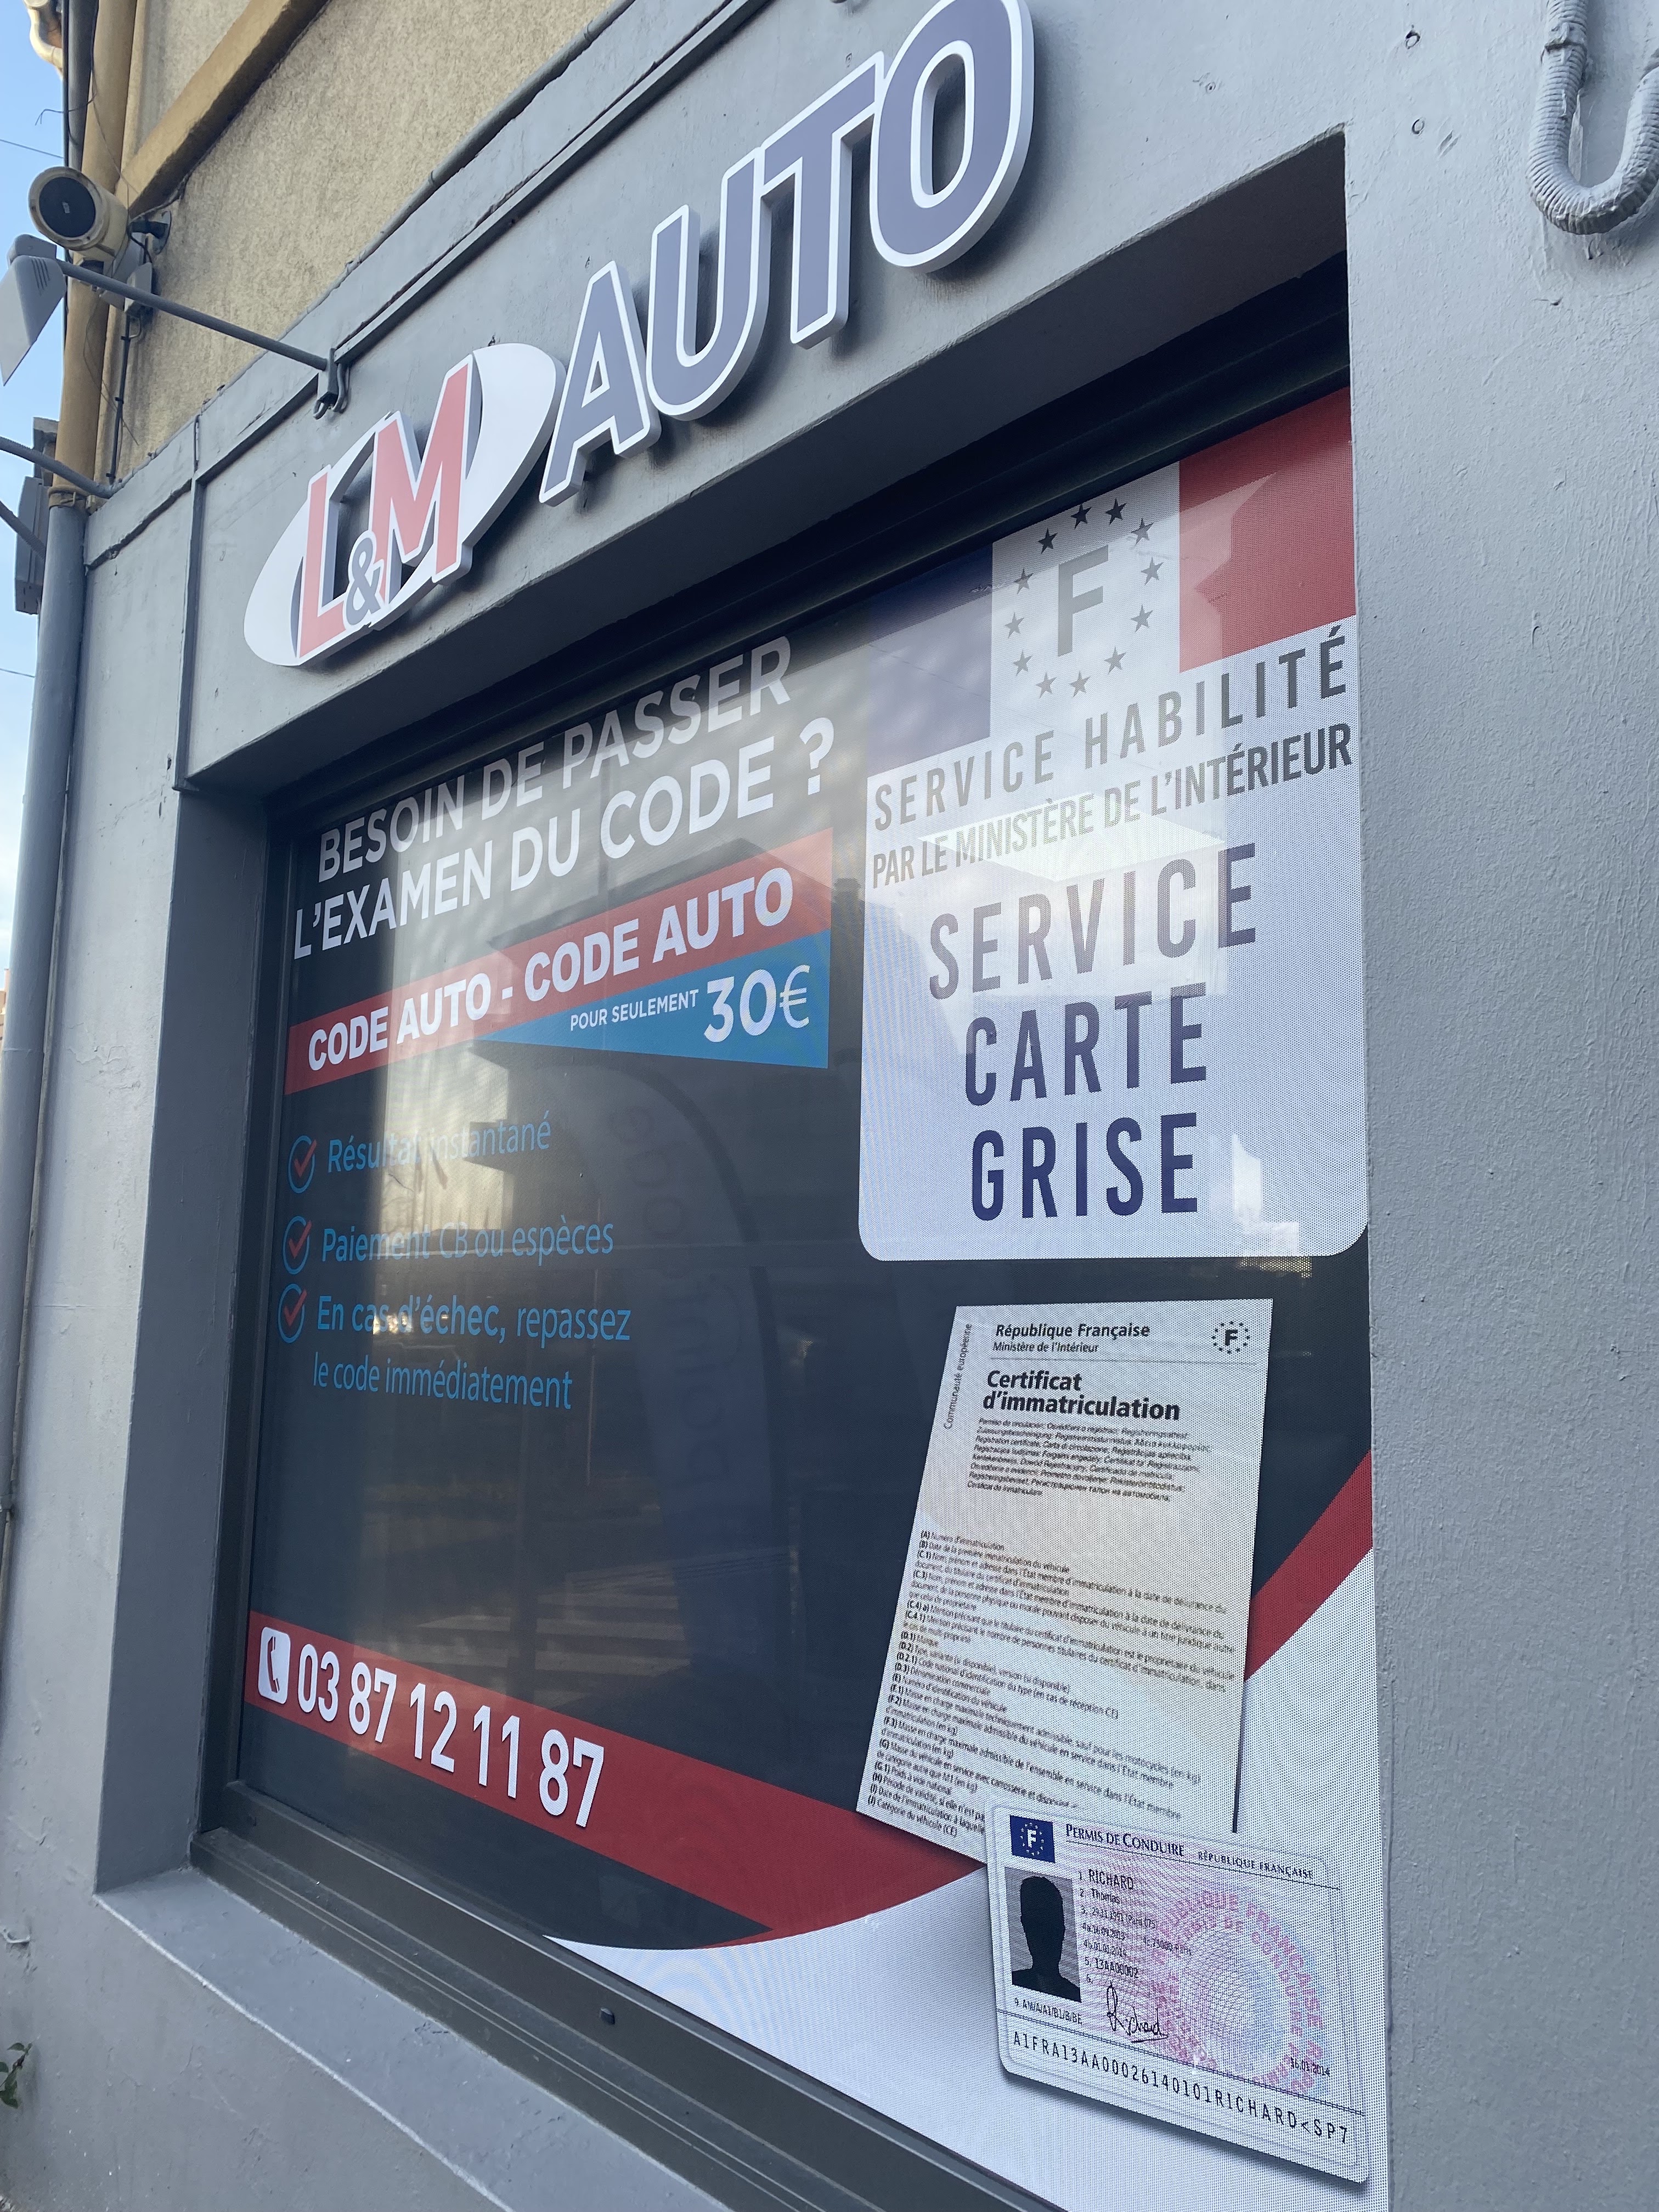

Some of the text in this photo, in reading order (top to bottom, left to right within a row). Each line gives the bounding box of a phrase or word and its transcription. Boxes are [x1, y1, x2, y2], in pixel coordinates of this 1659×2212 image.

[539, 0, 1035, 506] AUTO
[318, 635, 792, 883] BESOIN DE PASSER
[874, 624, 1347, 831] SERVICE HABILITÉ
[510, 810, 581, 891] DU
[600, 735, 775, 860] CODE
[799, 716, 835, 796] ?
[872, 842, 915, 890] PAR
[921, 834, 949, 877] LE
[955, 792, 1094, 867] MINISTÈRE
[1103, 780, 1141, 830] DE
[928, 842, 1256, 1000] SERVICE
[308, 1005, 389, 1072] CODE
[396, 972, 492, 1045] AUTO
[524, 921, 640, 1002] CODE
[652, 867, 794, 962] AUTO
[569, 964, 811, 1043] POUR SEULEMENT 30€
[964, 982, 1207, 1107] CARTE
[328, 1110, 551, 1173] Résultat instantané
[971, 1113, 1198, 1222] GRISE
[322, 1215, 614, 1266] Paiement CB ou espèces
[317, 1296, 344, 1331] En
[352, 1305, 390, 1334] cas
[517, 1305, 631, 1348] repassez
[993, 1342, 1035, 1353] Ministère
[1037, 1342, 1049, 1353] de
[996, 1323, 1150, 1340] République Française
[313, 1352, 573, 1410] le code immédiatement
[944, 1373, 962, 1429] Communauté
[987, 1370, 1082, 1392] Certificat
[298, 1644, 604, 1828] 03 87 12 11 87
[1026, 1830, 1037, 1848] F
[1066, 1824, 1184, 1857] PERMIS DE CONDUIRE
[1198, 1850, 1255, 1870] RÉPUBLIQUE
[1088, 1868, 1133, 1891] RICHARD
